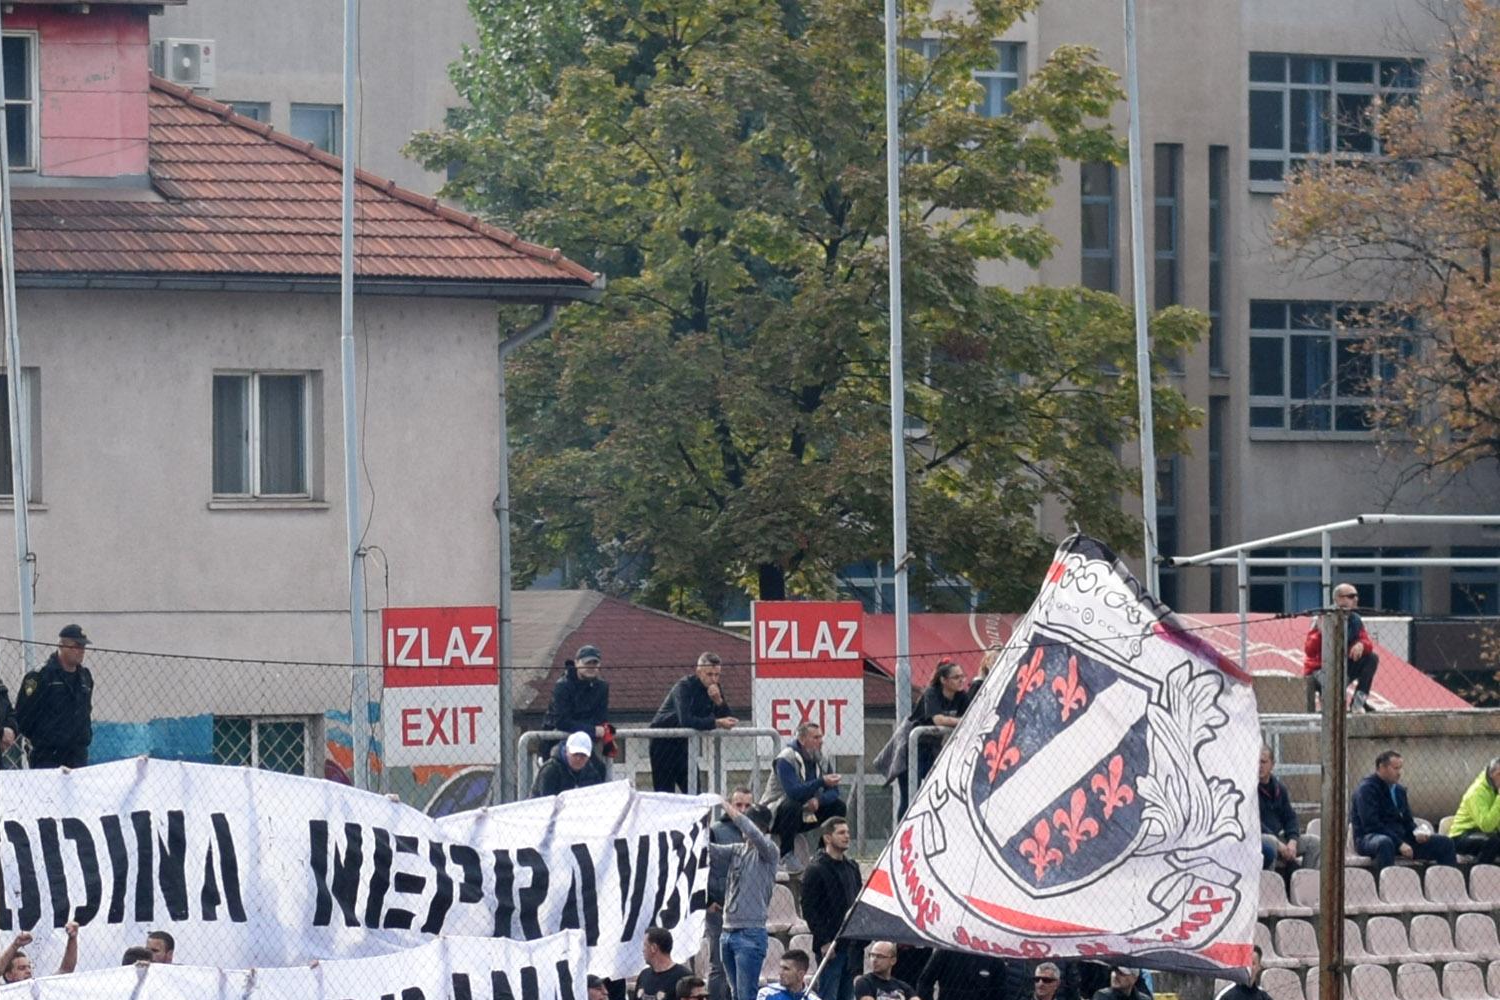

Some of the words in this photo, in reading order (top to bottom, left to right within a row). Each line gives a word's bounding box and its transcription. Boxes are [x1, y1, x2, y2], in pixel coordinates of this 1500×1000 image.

[387, 625, 494, 667] IZLAZ
[758, 620, 860, 659] IZLAZ
[401, 706, 484, 747] EXIT
[771, 698, 848, 736] EXIT
